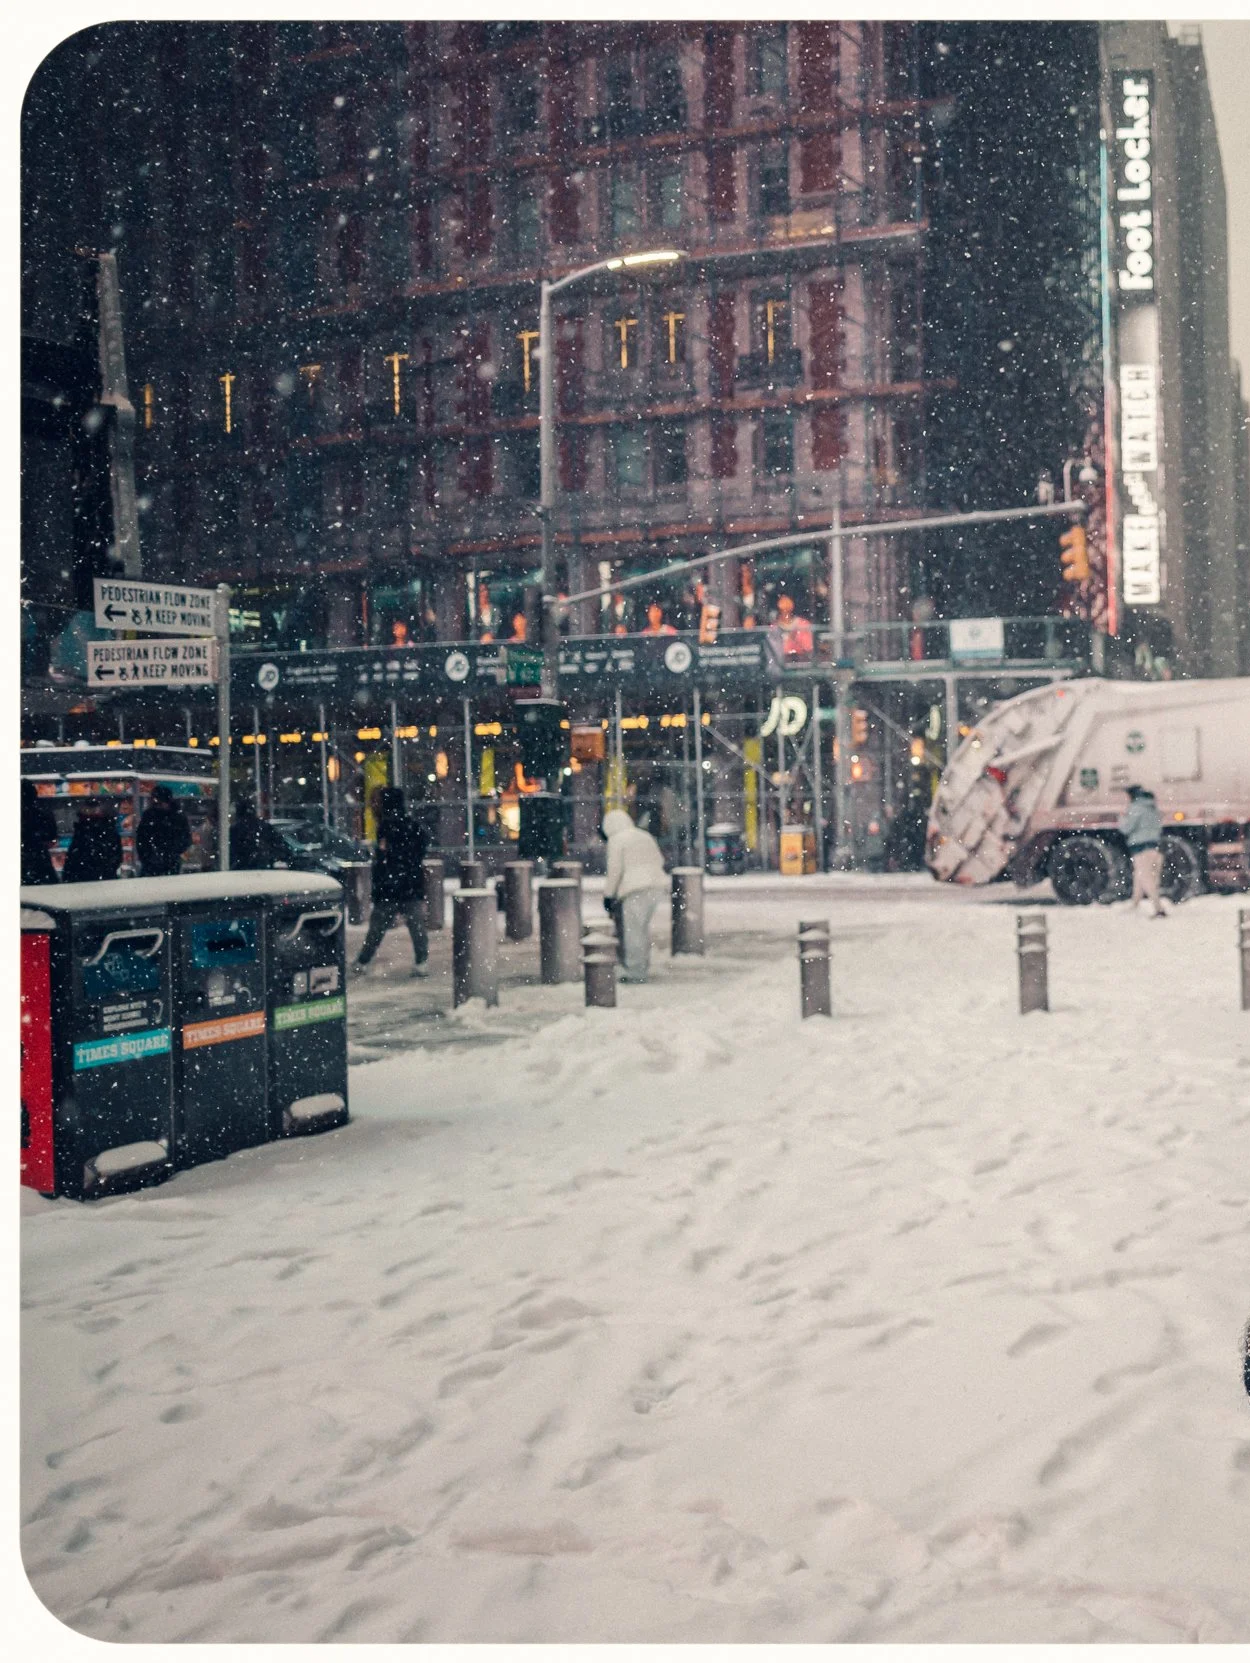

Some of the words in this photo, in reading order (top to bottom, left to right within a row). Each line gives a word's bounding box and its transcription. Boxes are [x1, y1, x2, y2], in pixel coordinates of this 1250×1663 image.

[101, 586, 161, 604] PEDESTRIAN
[164, 591, 187, 607] FLOW
[189, 594, 210, 610] ZONE
[155, 609, 177, 625] KEEP
[180, 612, 211, 628] MOVING
[93, 647, 149, 662] PEDESTRIAN
[153, 646, 178, 661] FLOW
[182, 645, 208, 660] ZONE
[143, 664, 167, 678] KEEP
[171, 663, 209, 678] MOVING
[760, 696, 807, 736] JD
[185, 1025, 222, 1043] TIMES
[223, 1016, 264, 1036] SQUARE
[77, 1043, 118, 1064] TIMES
[120, 1033, 168, 1057] SQUARE
